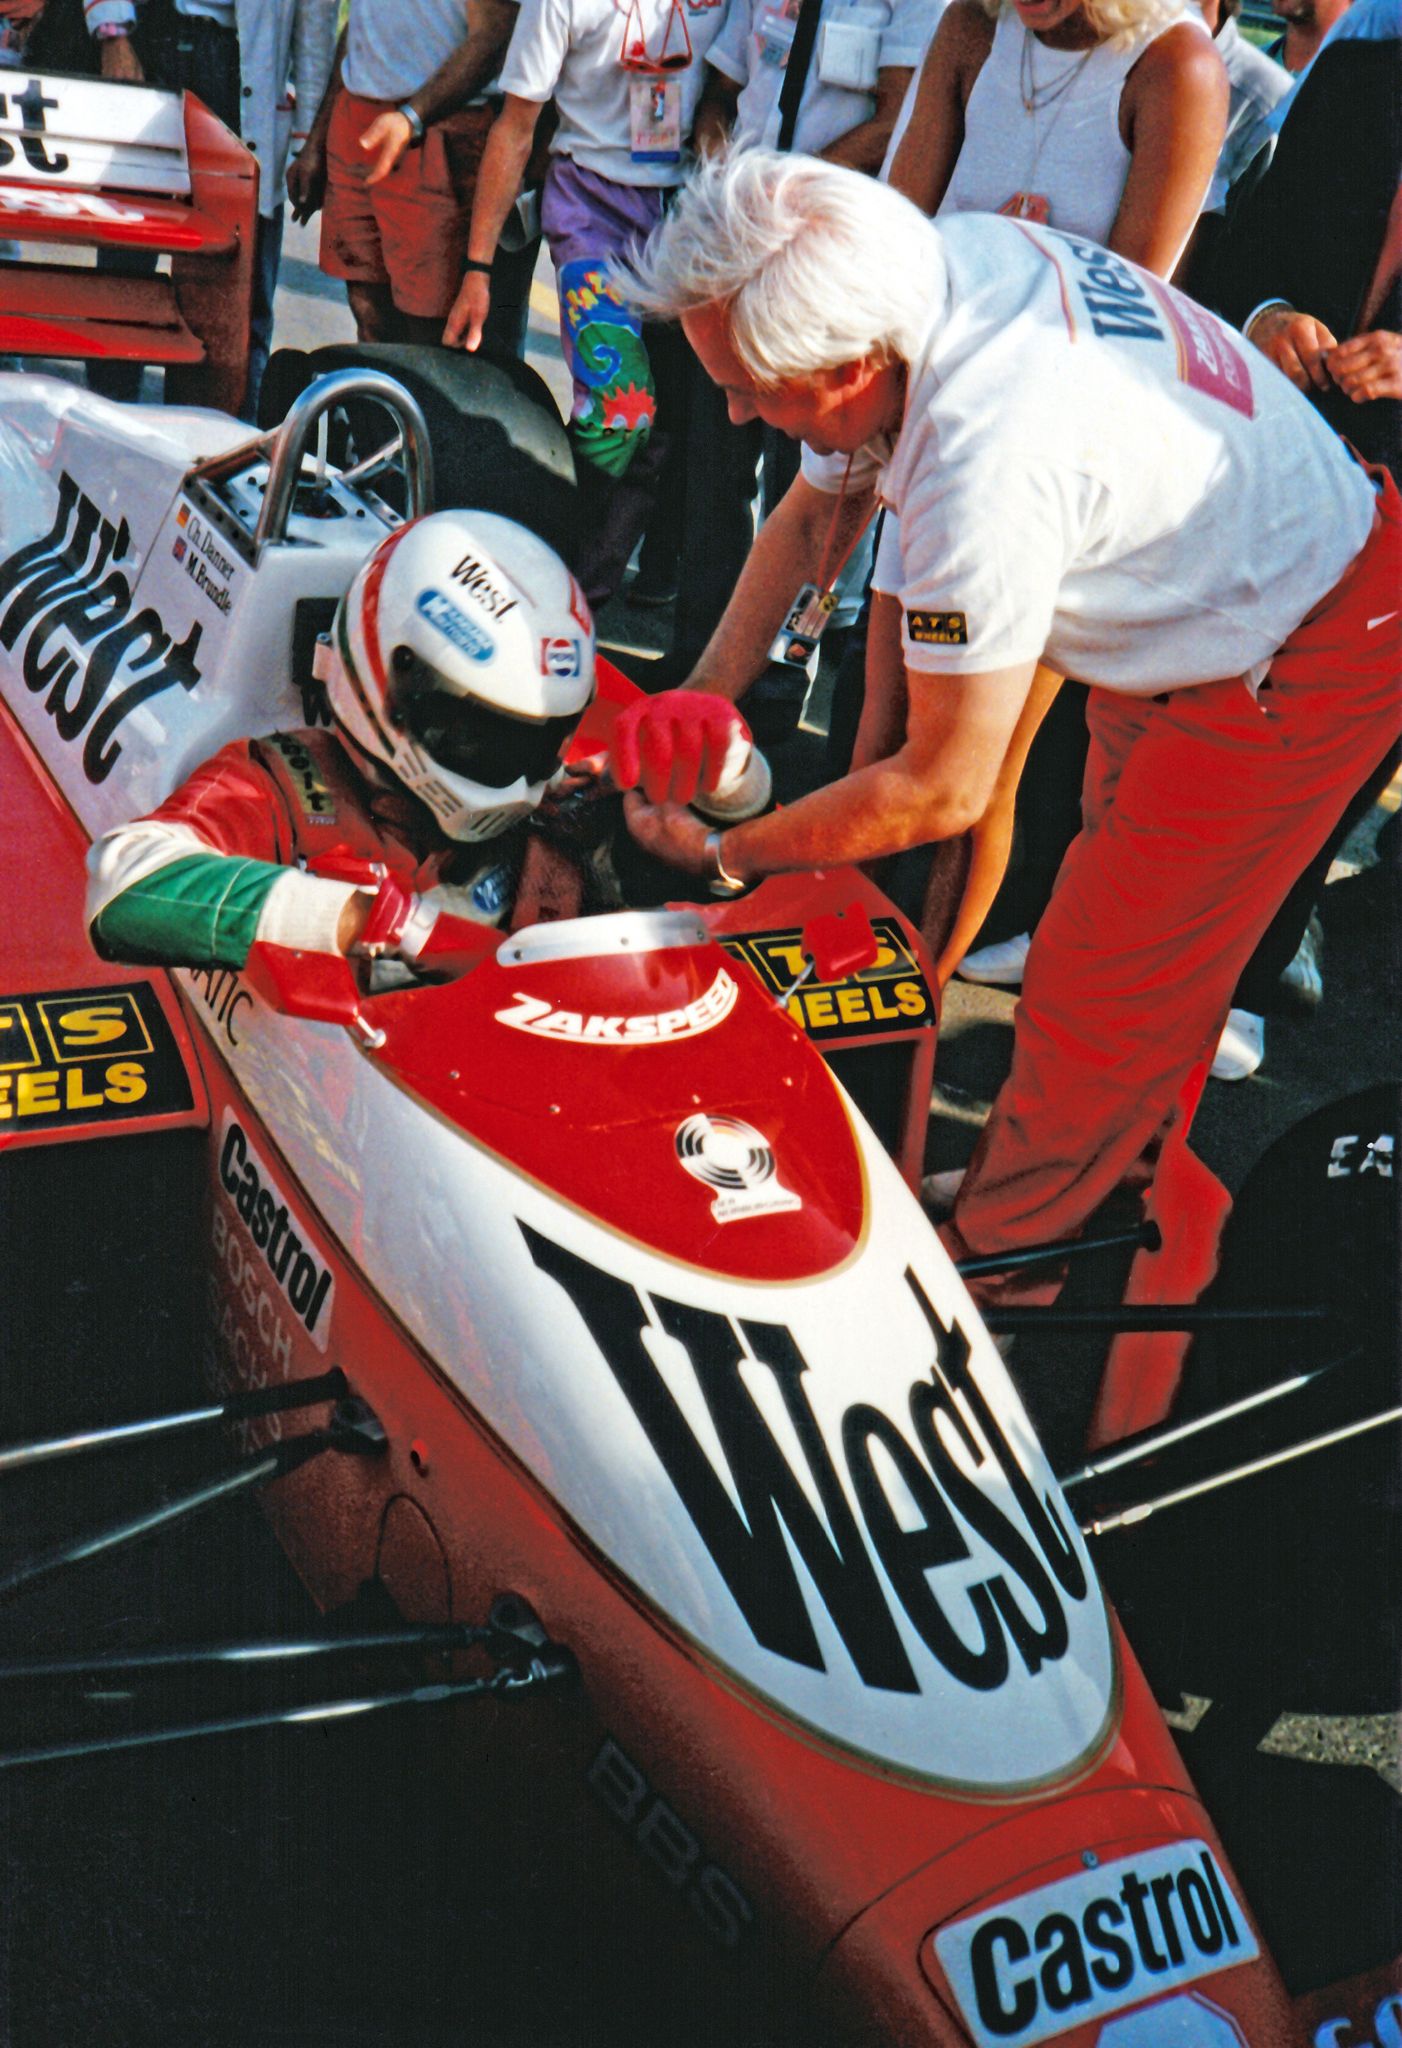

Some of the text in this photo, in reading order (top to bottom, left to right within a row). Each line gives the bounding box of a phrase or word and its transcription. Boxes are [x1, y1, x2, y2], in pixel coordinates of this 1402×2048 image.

[0, 469, 203, 784] West
[450, 554, 519, 624] West
[495, 967, 739, 1045] ZAKSPEED
[213, 1208, 293, 1379] BOSCH
[220, 1123, 333, 1333] Castrol
[513, 1214, 1089, 1697] West
[587, 1737, 755, 1948] BBS
[970, 1850, 1241, 2037] Castrol
